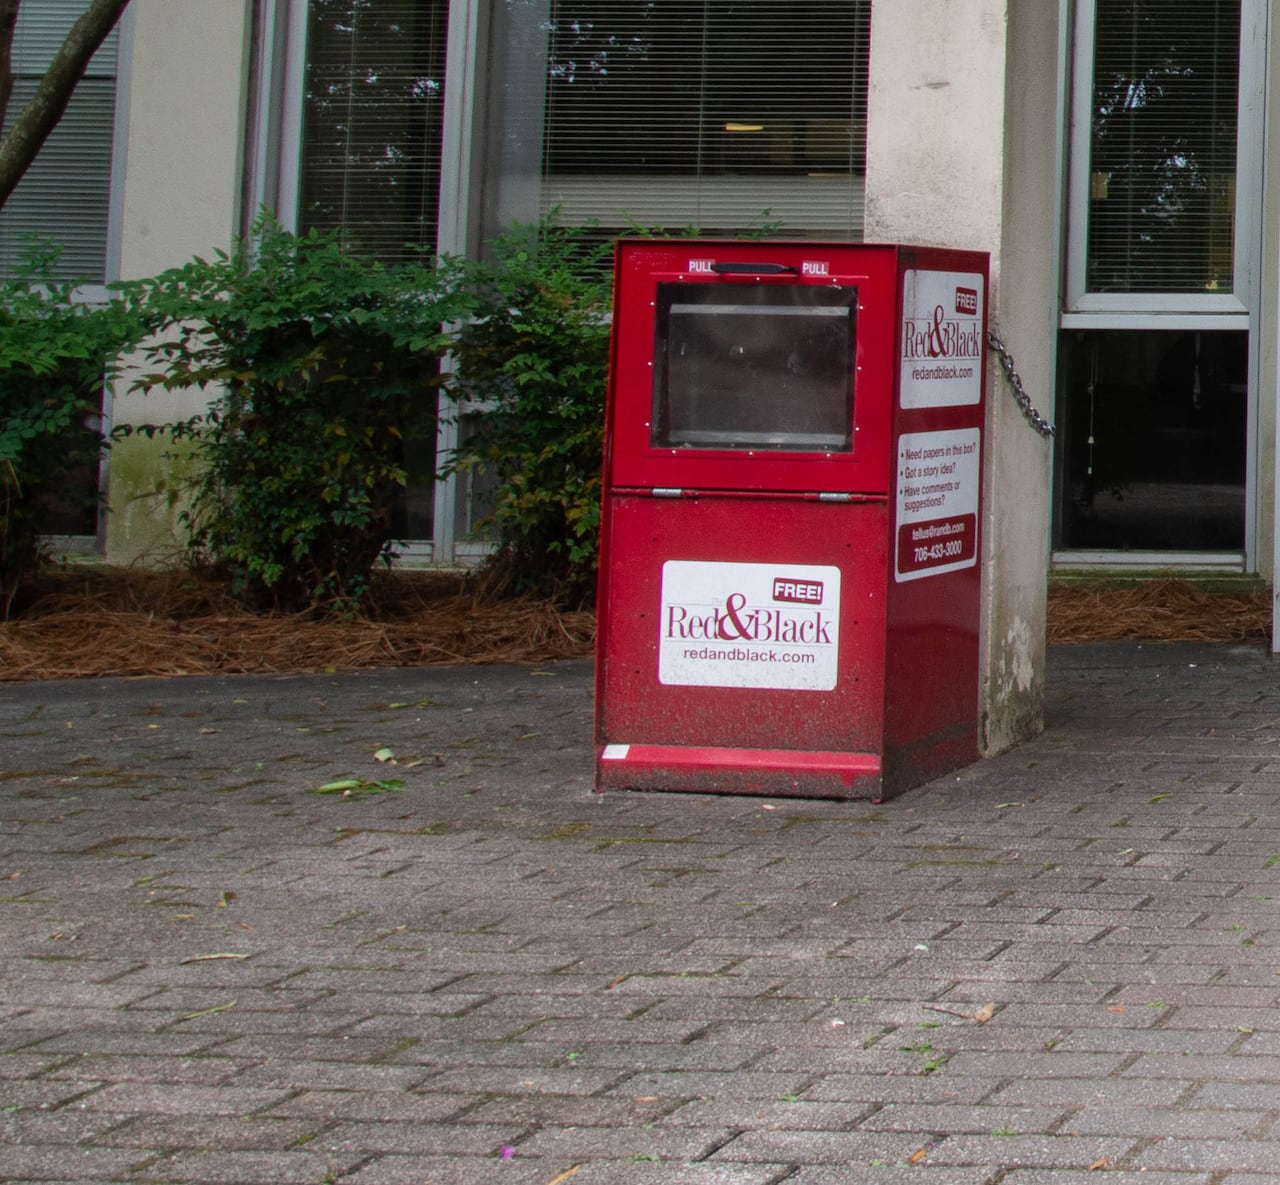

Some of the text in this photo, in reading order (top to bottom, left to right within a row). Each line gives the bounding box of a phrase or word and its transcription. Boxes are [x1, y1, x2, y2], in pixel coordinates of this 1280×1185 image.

[688, 260, 713, 273] PULL
[802, 262, 827, 275] PULL
[956, 293, 977, 310] FREE!
[912, 366, 973, 380] redandblack.com
[905, 441, 976, 461] Need papers in this box?
[905, 466, 916, 479] Got
[923, 466, 939, 478] story
[941, 462, 956, 474] idea?
[904, 481, 960, 497] Have comments or
[904, 494, 945, 512] suggestions?
[912, 522, 965, 541] tellus@randb.com
[914, 539, 962, 563] 706-433-3000
[774, 581, 822, 601] FREE!
[683, 647, 816, 664] redandblack.com
